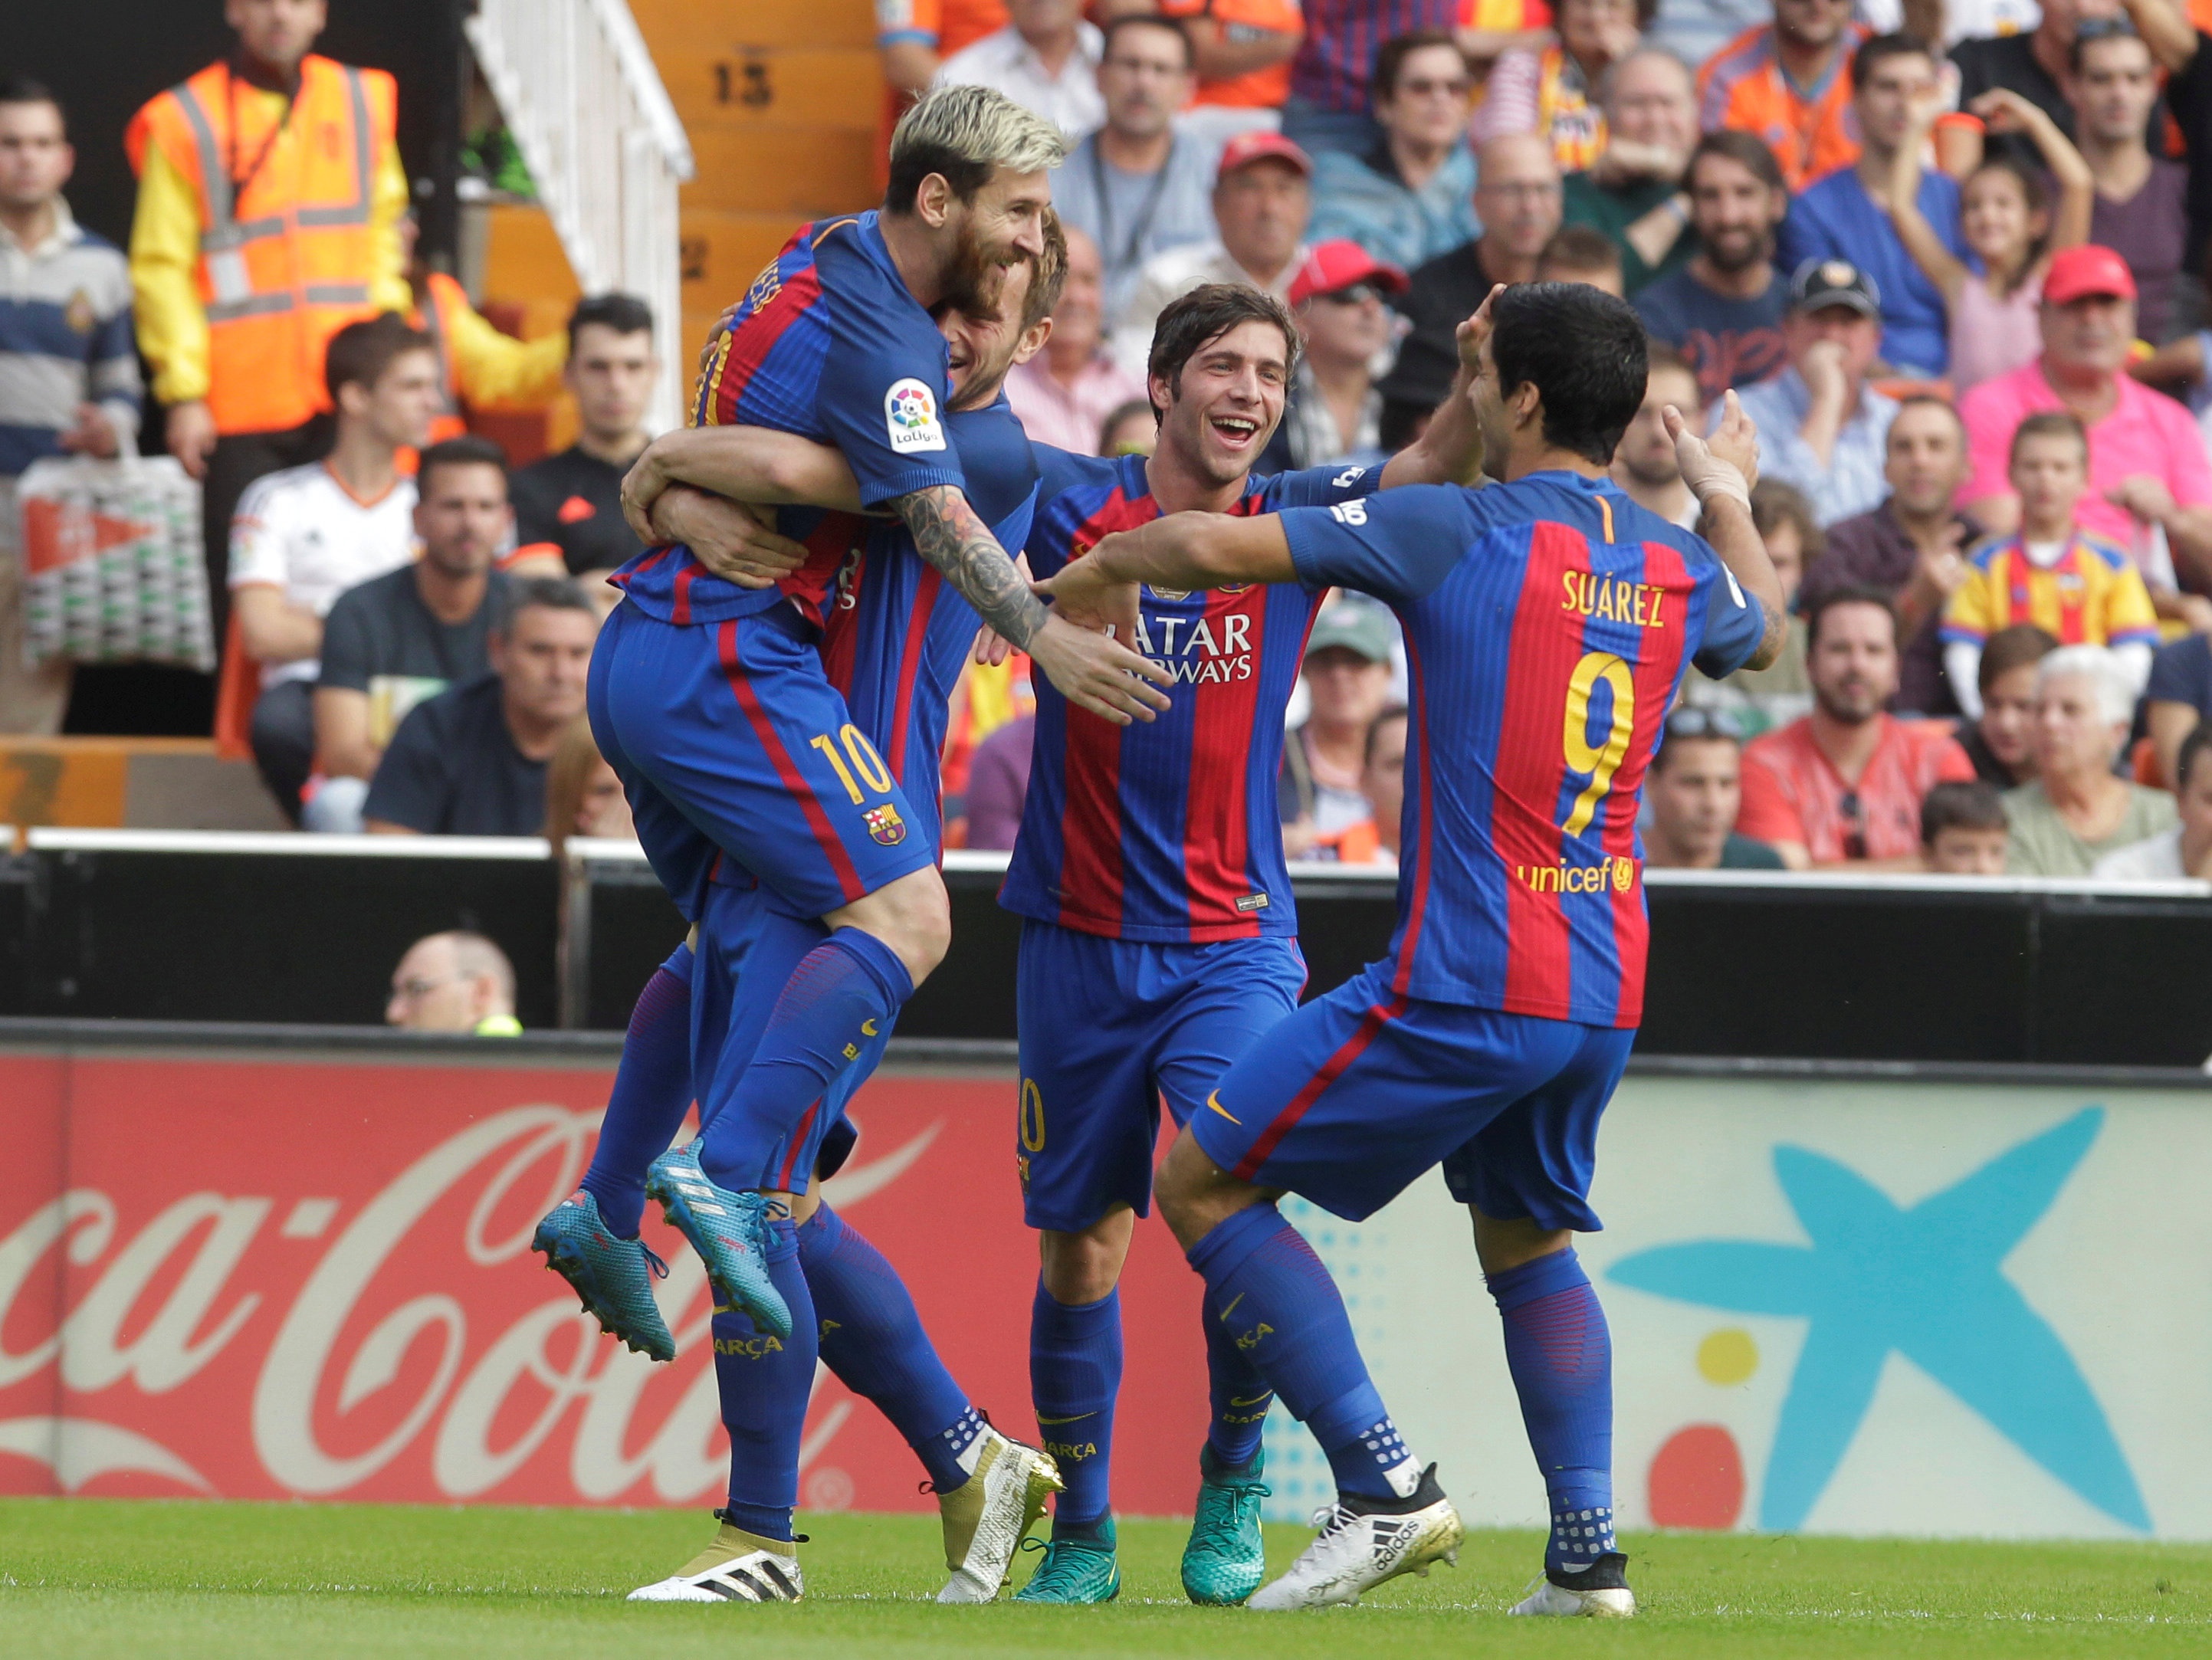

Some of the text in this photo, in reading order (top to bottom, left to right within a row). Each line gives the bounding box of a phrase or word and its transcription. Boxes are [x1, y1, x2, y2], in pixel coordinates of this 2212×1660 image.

[896, 430, 938, 444] LaLiga
[1561, 569, 1666, 628] SUÁREZ
[1105, 613, 1252, 657] ATAR
[809, 723, 892, 805] 10
[1562, 651, 1635, 838] 9
[1518, 856, 1612, 893] unicef
[1377, 1520, 1419, 1571] adidas
